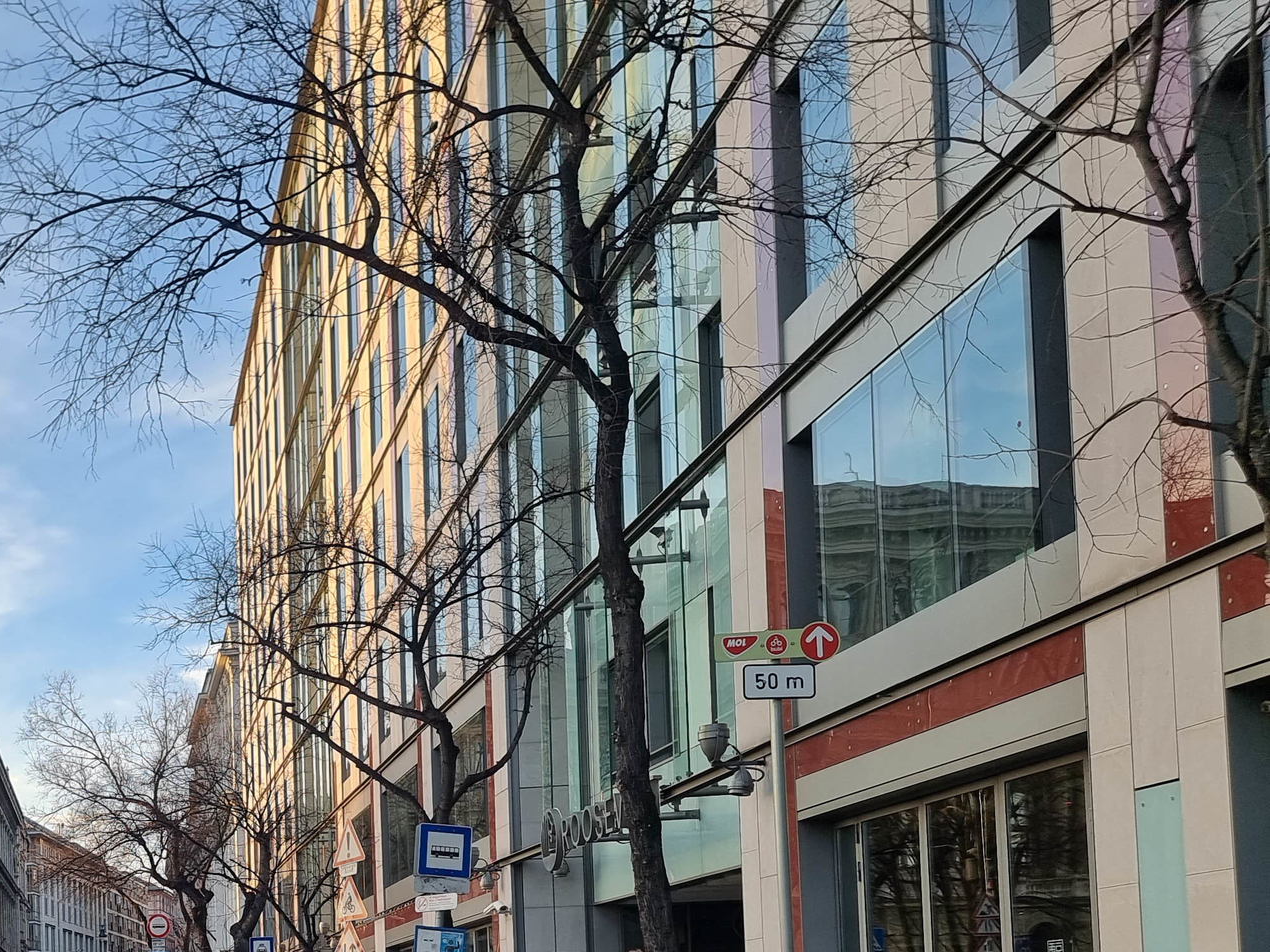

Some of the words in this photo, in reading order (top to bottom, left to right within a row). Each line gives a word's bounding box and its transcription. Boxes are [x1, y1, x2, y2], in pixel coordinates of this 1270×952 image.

[727, 638, 746, 648] MOL
[755, 673, 778, 690] 50
[786, 676, 804, 689] m
[561, 792, 623, 855] ROOSEV
